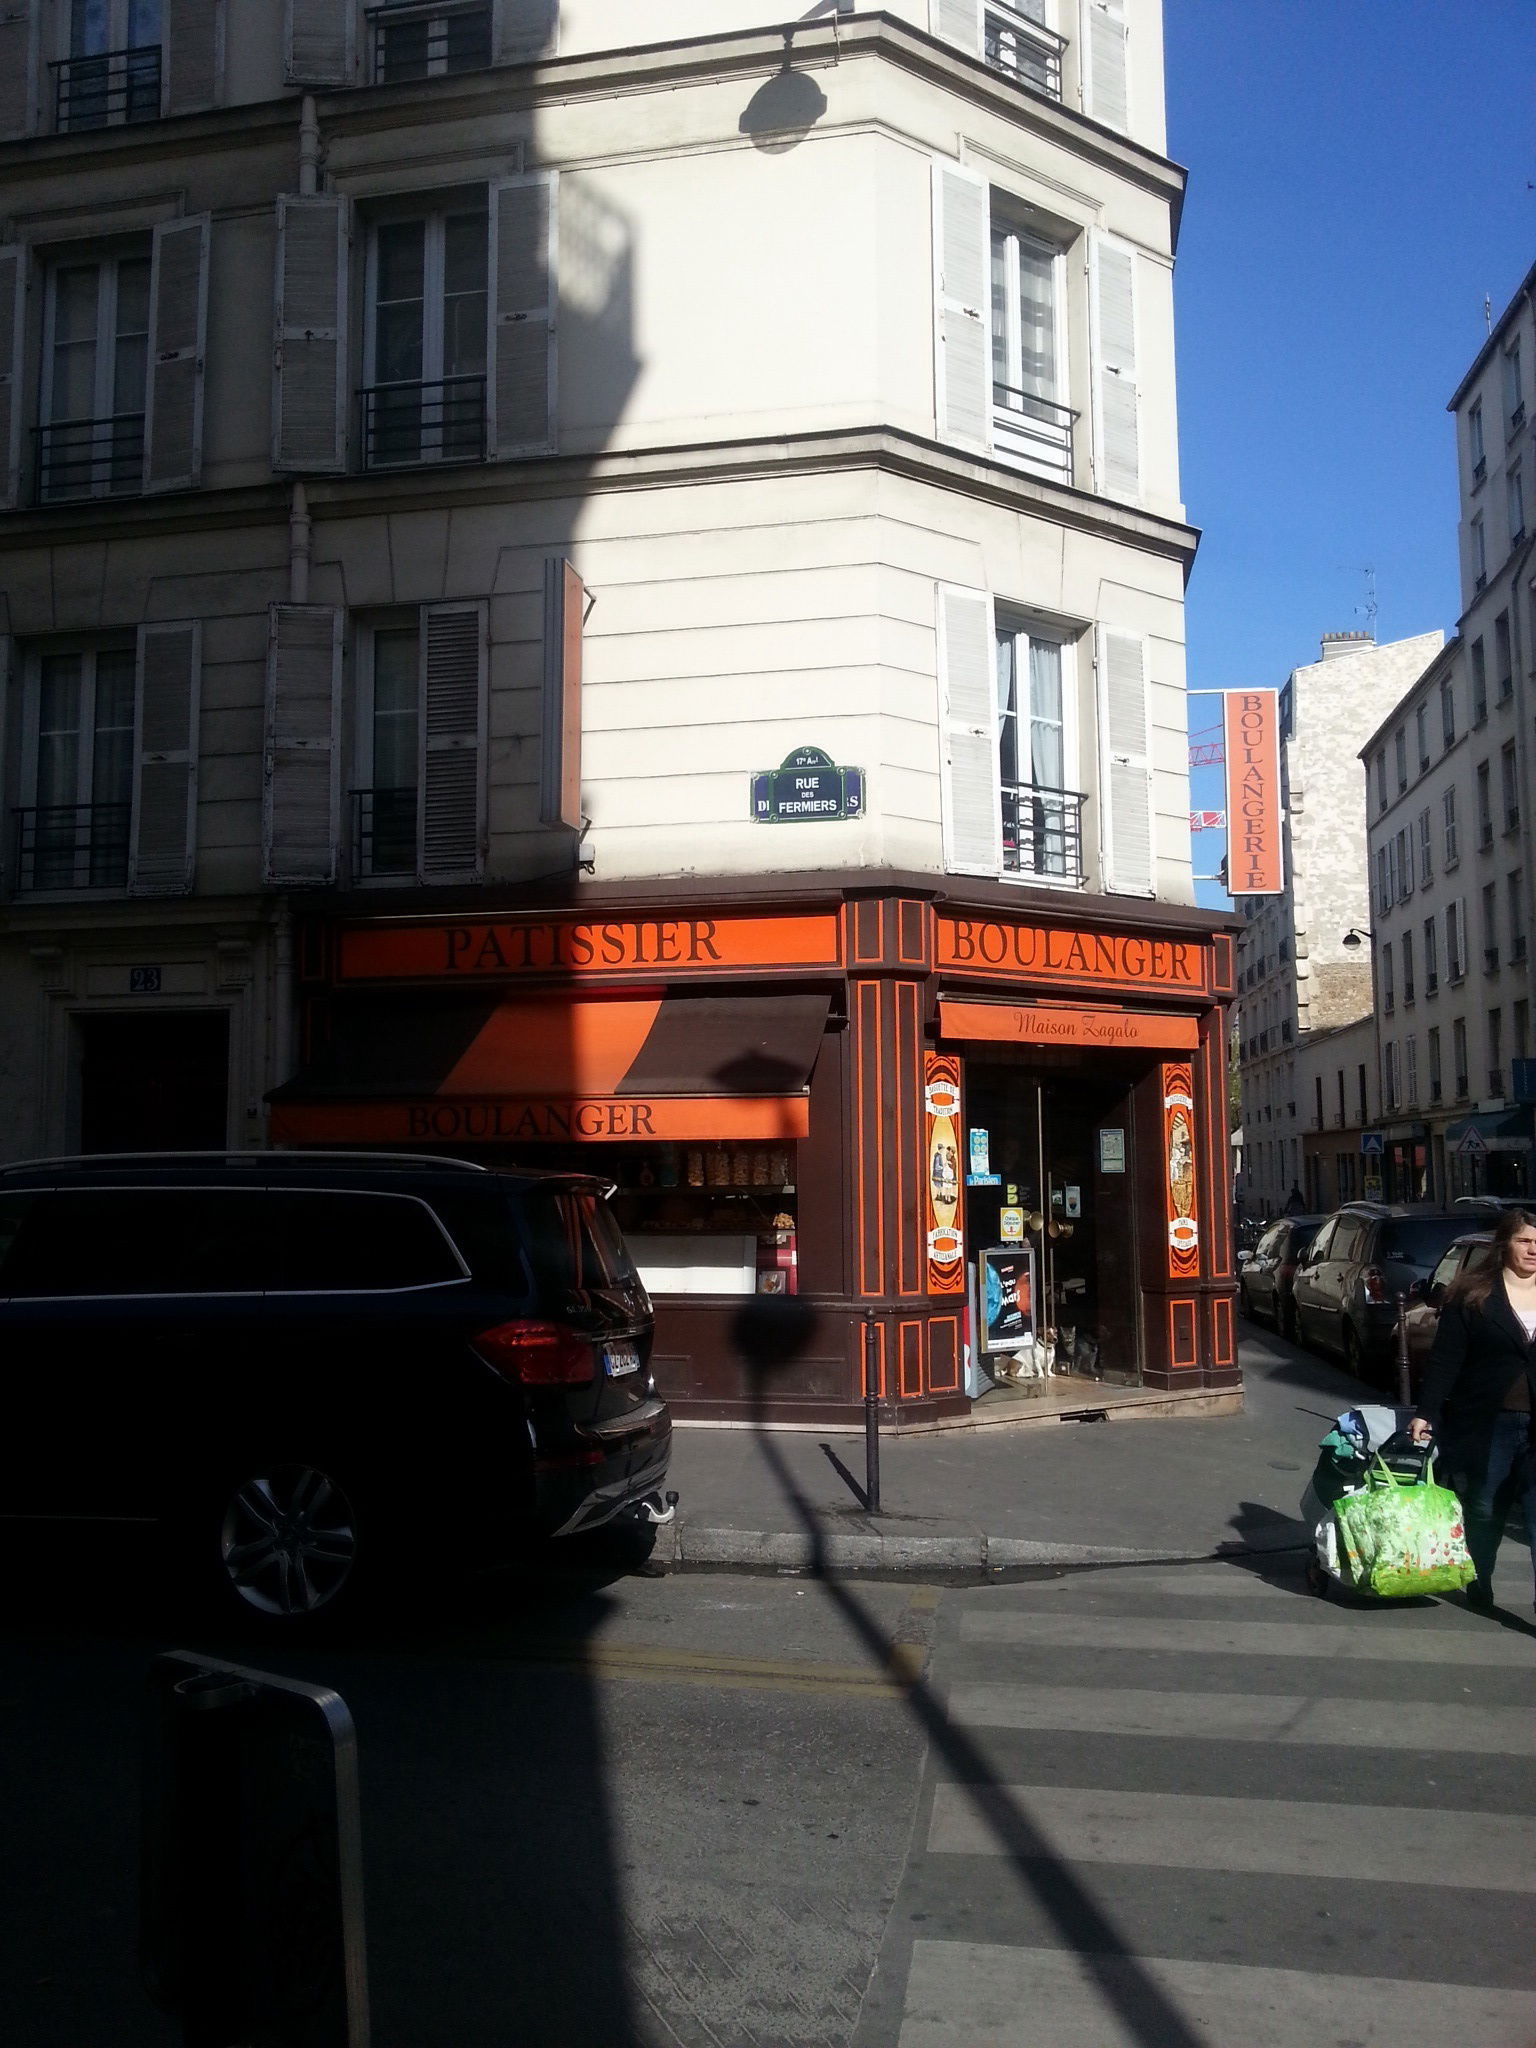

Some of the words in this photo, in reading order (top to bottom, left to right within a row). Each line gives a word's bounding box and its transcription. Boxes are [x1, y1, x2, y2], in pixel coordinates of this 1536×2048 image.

[796, 778, 819, 789] RUE
[1241, 695, 1267, 889] BOULANGERIE
[779, 800, 837, 813] FERMIERS
[445, 920, 722, 969] PATISSIER
[952, 920, 1191, 980] BOULANGER
[1013, 1012, 1076, 1035] Maison
[1082, 1015, 1138, 1044] Zagalo
[408, 1104, 656, 1136] BOULANGER
